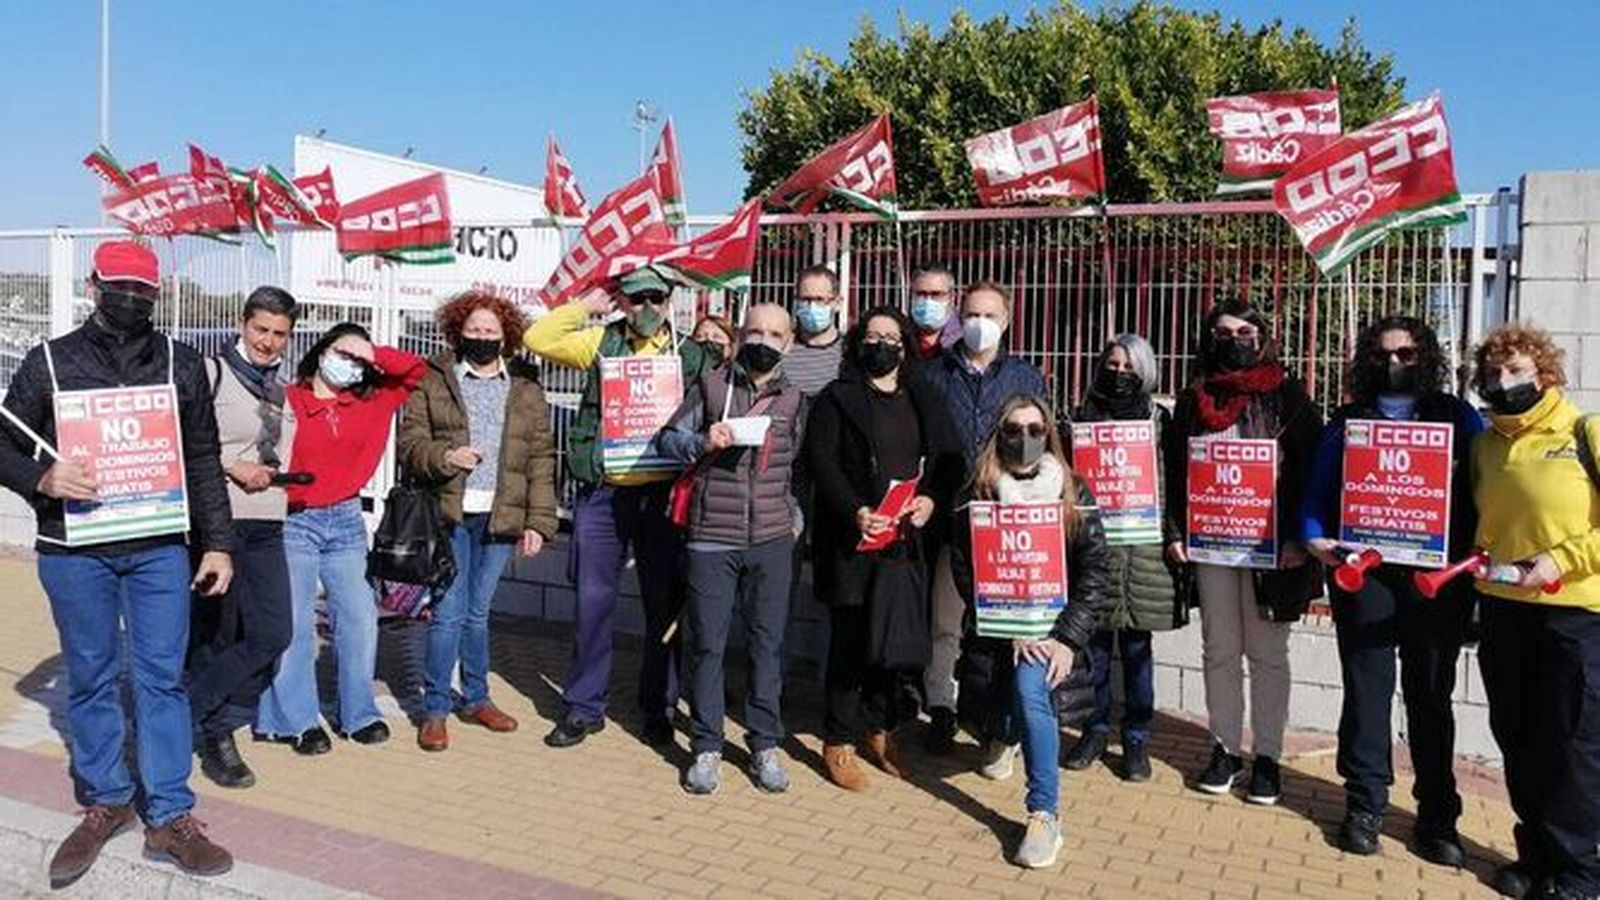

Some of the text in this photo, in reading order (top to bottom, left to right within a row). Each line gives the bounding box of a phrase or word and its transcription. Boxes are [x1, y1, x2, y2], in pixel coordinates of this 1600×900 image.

[629, 379, 655, 397] NO
[95, 393, 170, 413] CCOO
[102, 418, 141, 442] NO
[1098, 427, 1150, 442] CCOO
[1376, 427, 1446, 447] CCOO
[101, 437, 170, 453] TRABAJO
[1213, 445, 1271, 461] CCOO
[95, 451, 176, 469] DOMINGOS
[1100, 446, 1127, 468] NO
[1378, 448, 1411, 473] NO
[1216, 463, 1242, 485] NO
[1363, 471, 1425, 486] A LOS
[1205, 485, 1256, 497] A LOS
[1344, 481, 1445, 498] DOMINGOS
[1189, 493, 1272, 508] DOMINGOS
[1386, 496, 1400, 506] Y
[1000, 507, 1058, 525] CCOO
[1224, 506, 1235, 515] Y
[1349, 504, 1439, 521] FESTIVOS
[1193, 514, 1267, 528] FESTIVOS
[1359, 515, 1427, 532] GRATIS
[1200, 524, 1259, 537] GRATIS
[1001, 529, 1032, 551] NO
